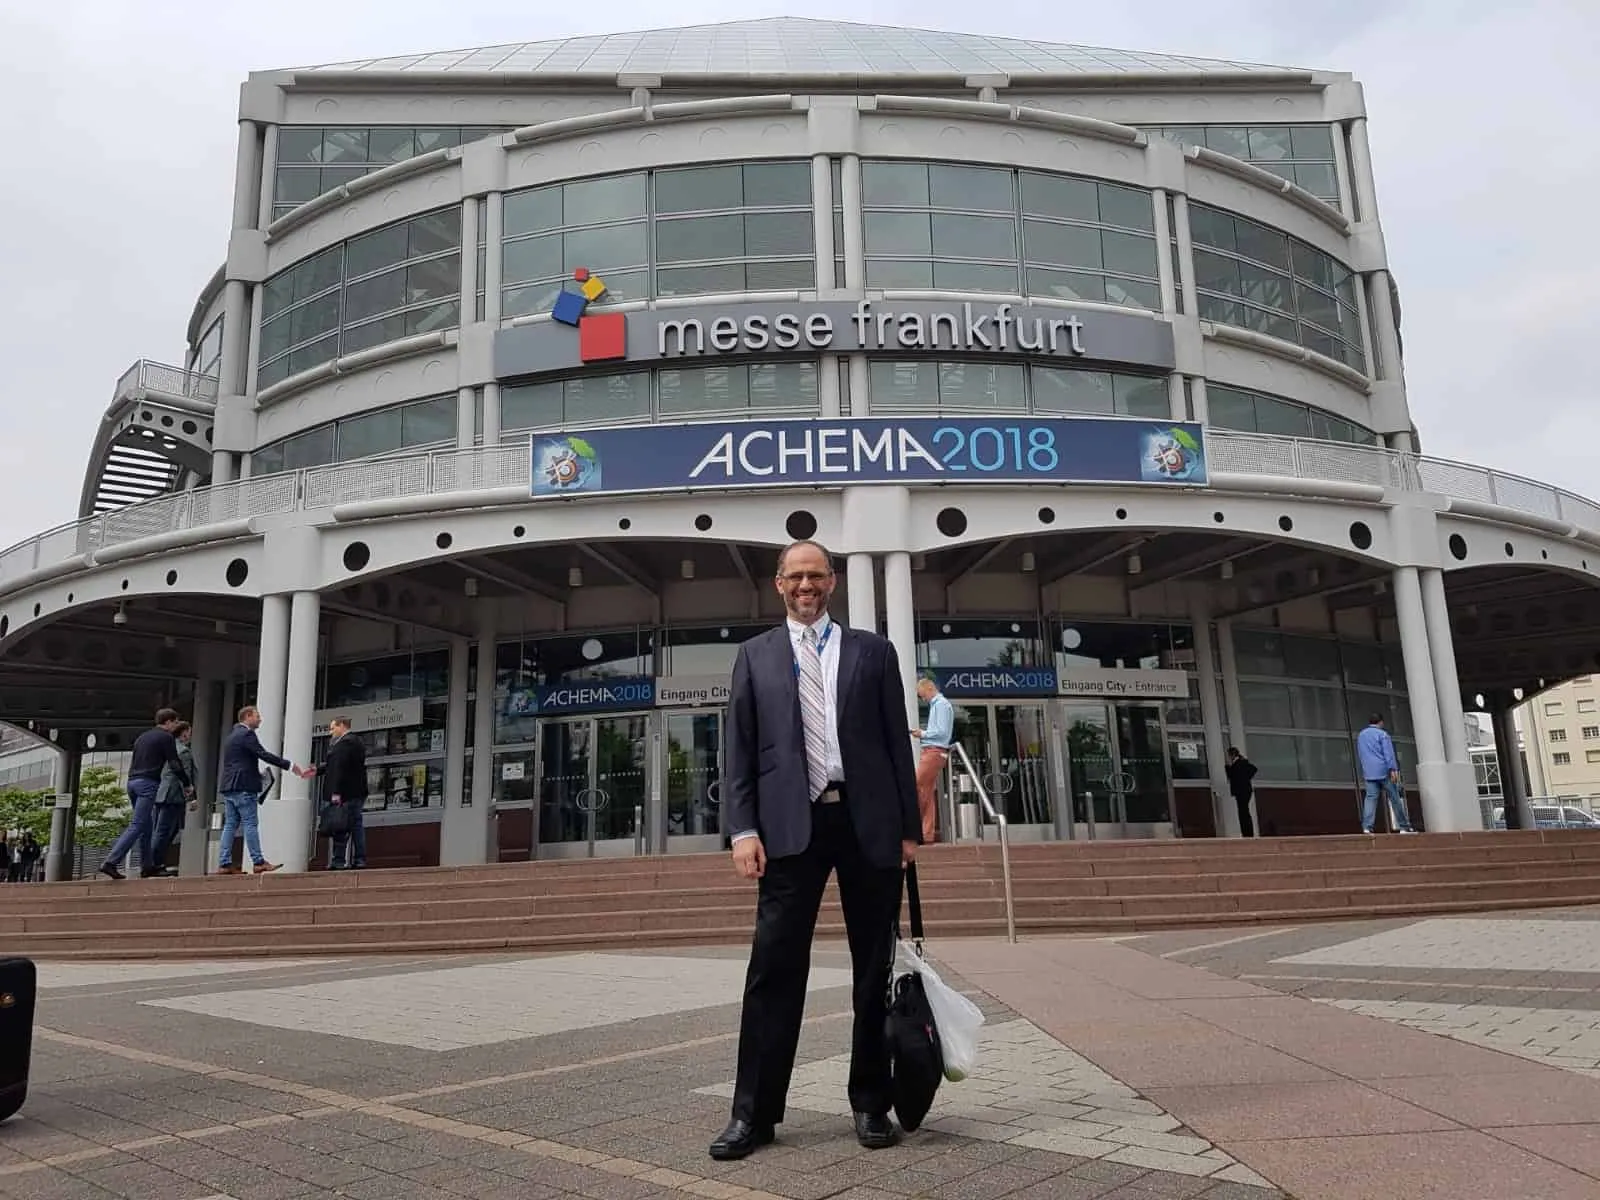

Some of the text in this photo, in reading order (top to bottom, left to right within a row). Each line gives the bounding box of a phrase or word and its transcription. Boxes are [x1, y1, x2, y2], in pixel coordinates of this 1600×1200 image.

[657, 300, 1086, 355] messe frankfurt
[1062, 680, 1103, 692] Eingang
[1106, 680, 1126, 693] City
[1135, 681, 1177, 692] Entrance
[660, 688, 708, 701] Eingang
